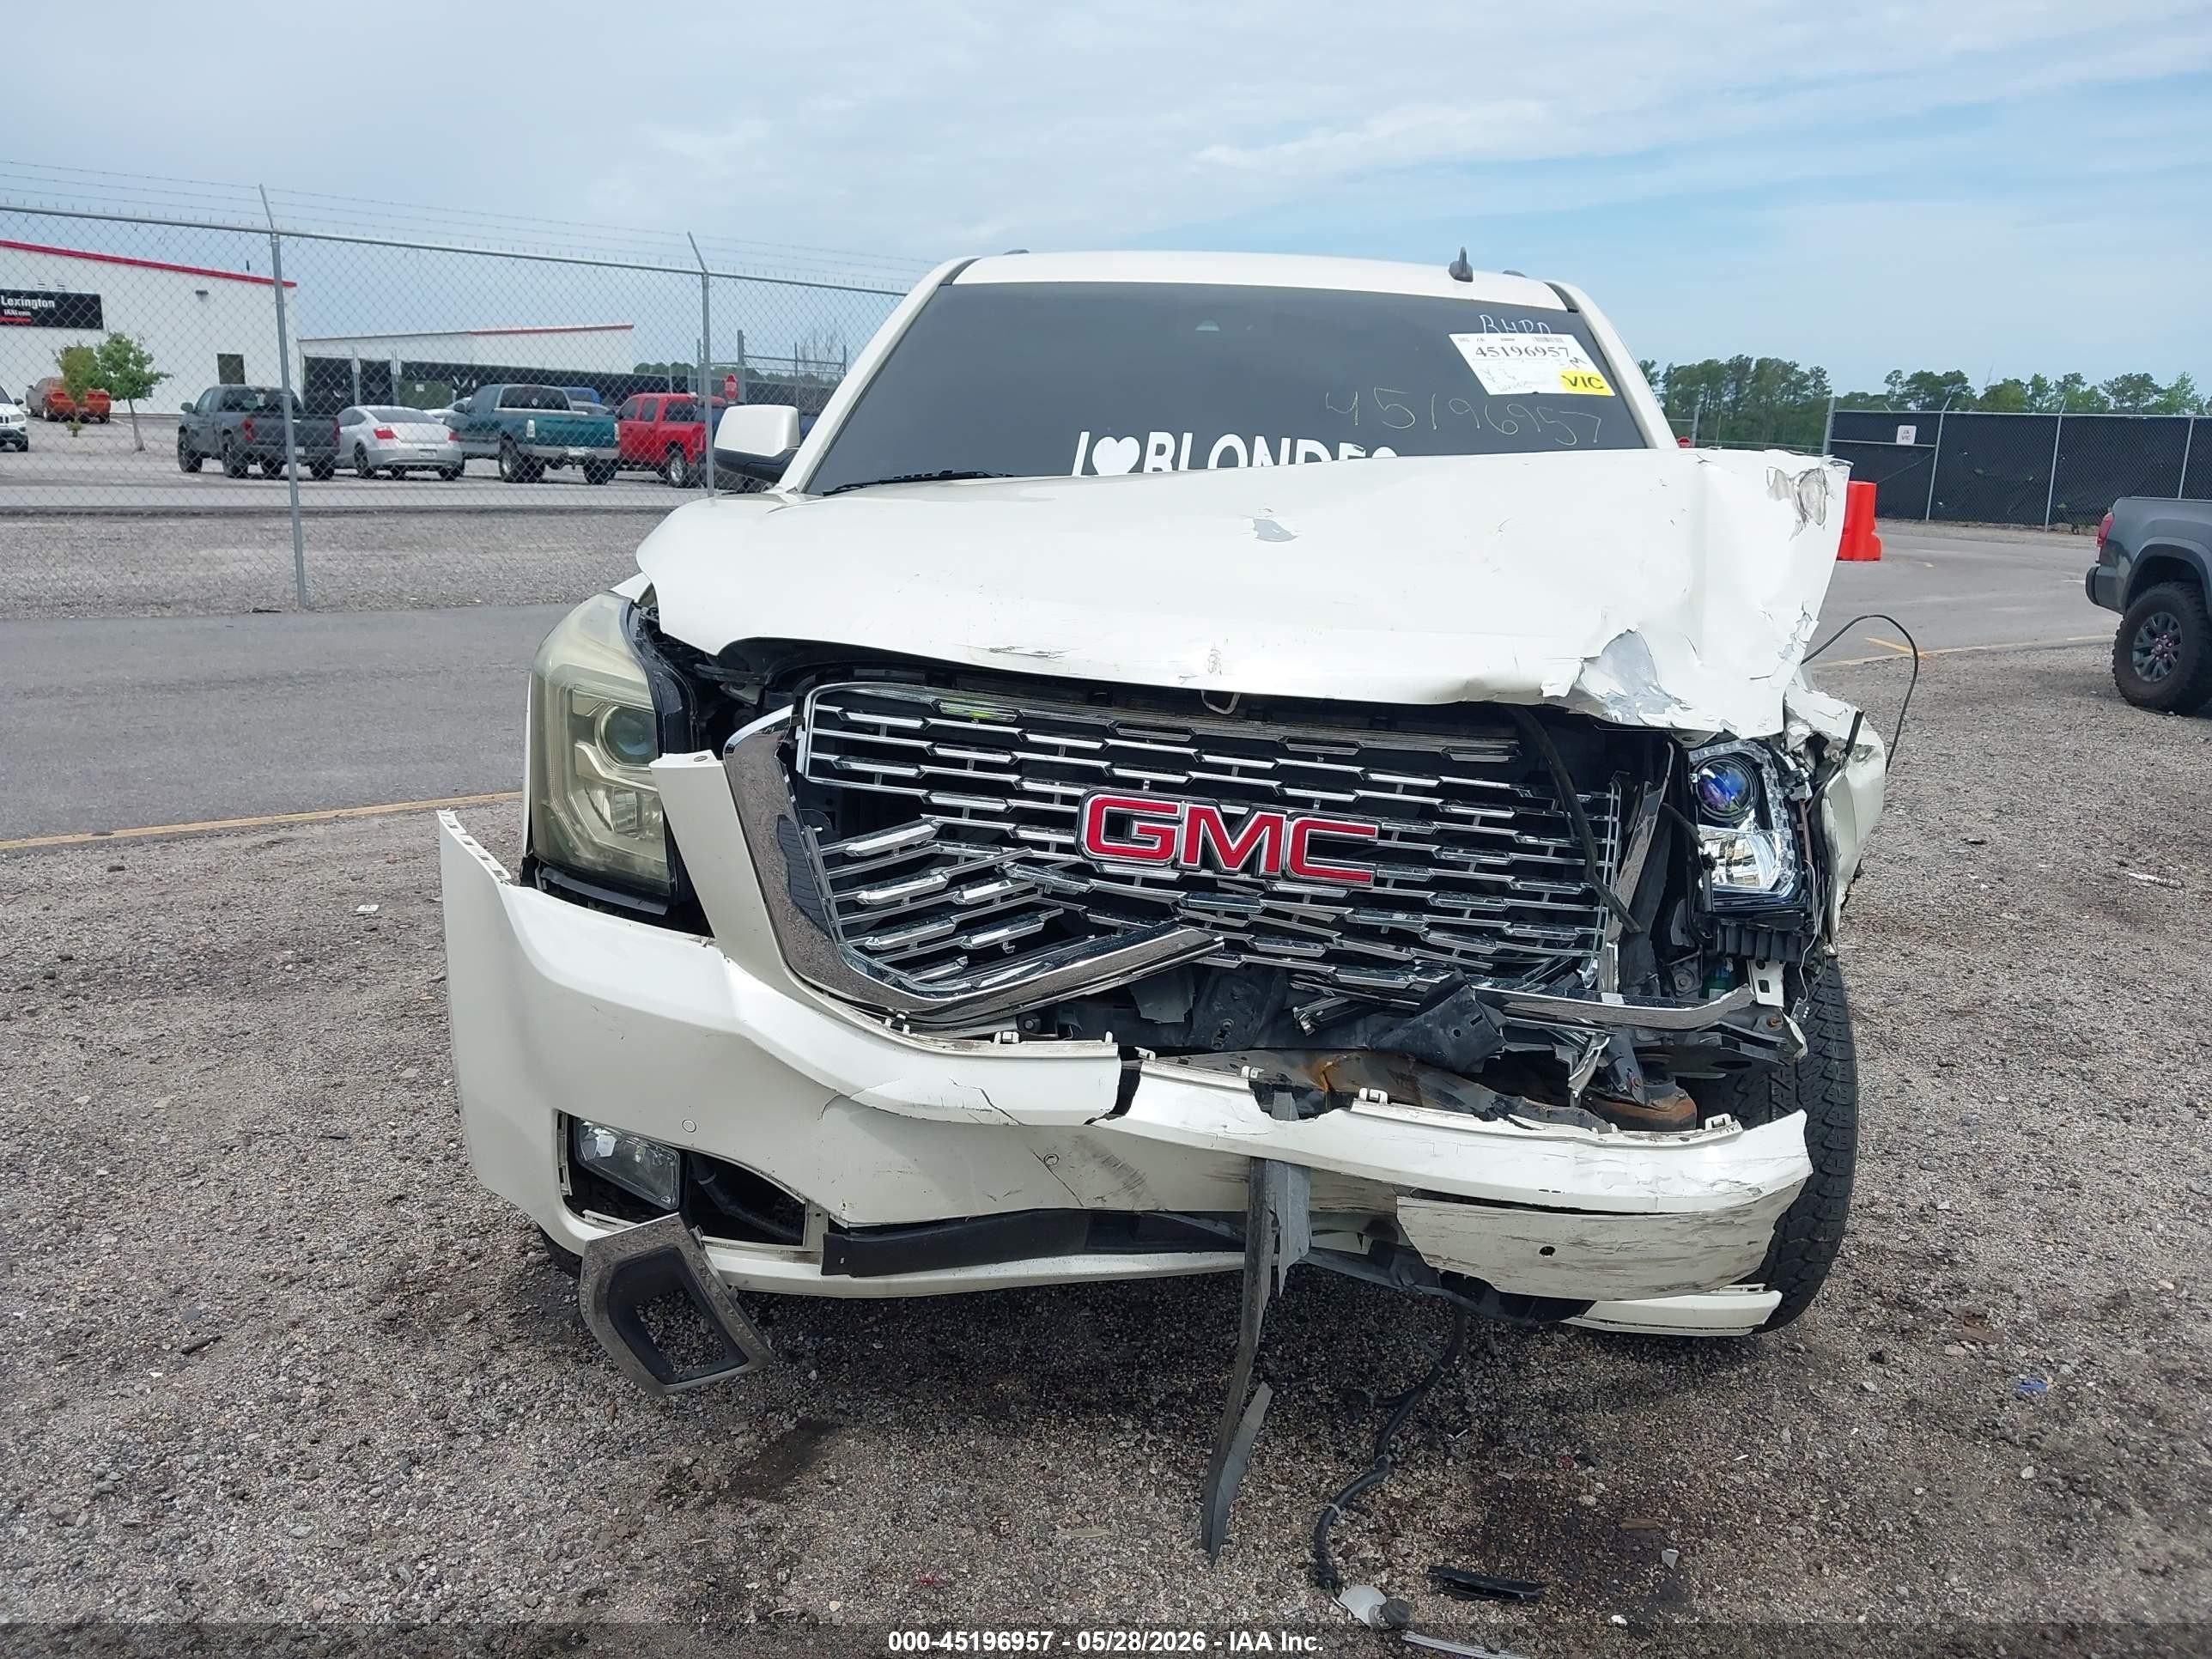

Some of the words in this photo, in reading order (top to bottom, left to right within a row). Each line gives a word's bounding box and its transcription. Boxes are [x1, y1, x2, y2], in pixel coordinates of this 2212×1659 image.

[1, 295, 56, 310] Lexington
[1475, 346, 1570, 357] 45196957
[1561, 374, 1604, 390] VIC
[1325, 387, 1601, 446] 45196957
[1079, 789, 1379, 887] GMC
